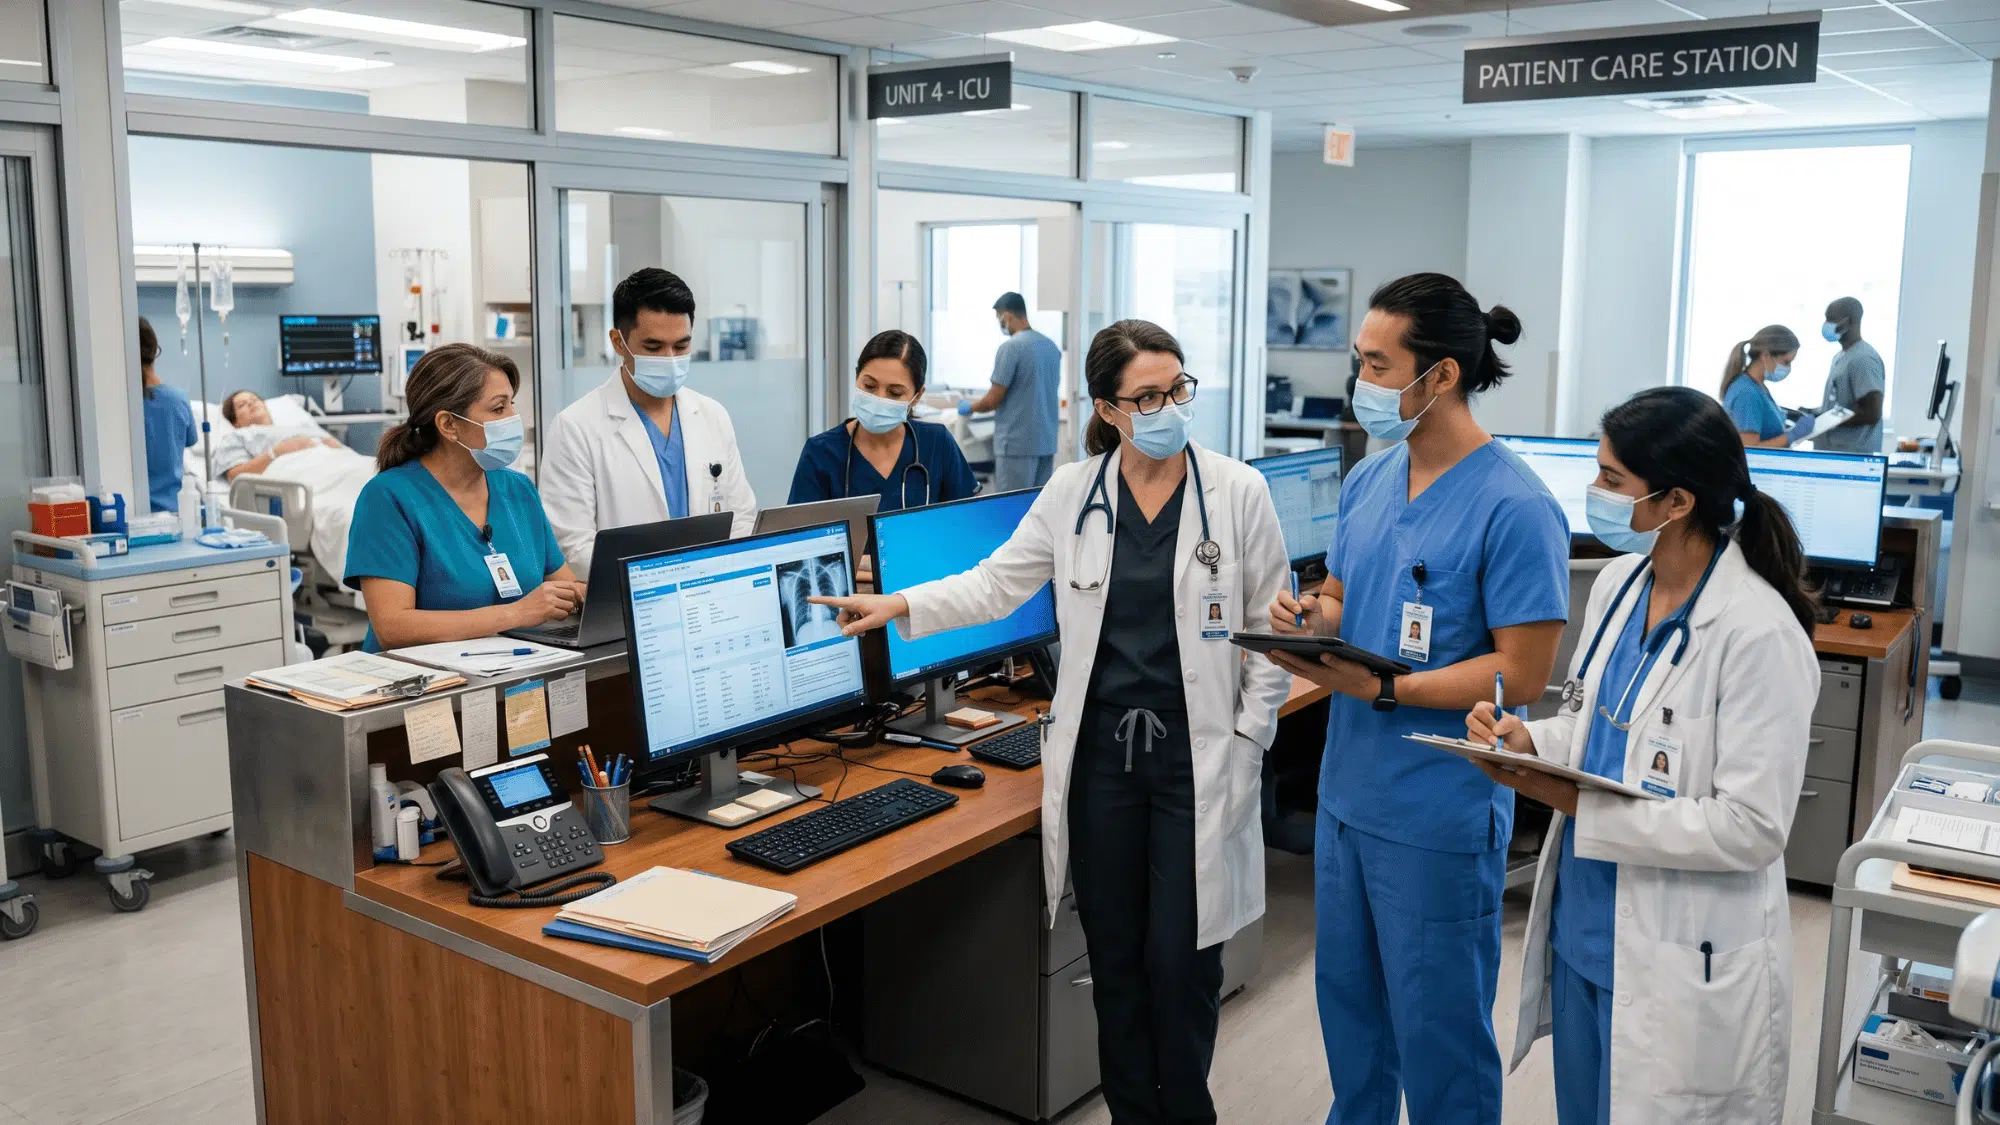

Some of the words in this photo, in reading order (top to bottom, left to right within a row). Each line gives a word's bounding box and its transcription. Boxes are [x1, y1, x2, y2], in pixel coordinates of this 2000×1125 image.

[1478, 58, 1584, 89] PATIENT
[1591, 51, 1664, 82] CARE
[1672, 42, 1799, 76] STATION
[885, 82, 928, 106] UNIT
[931, 81, 943, 102] 4
[958, 76, 991, 101] ICU
